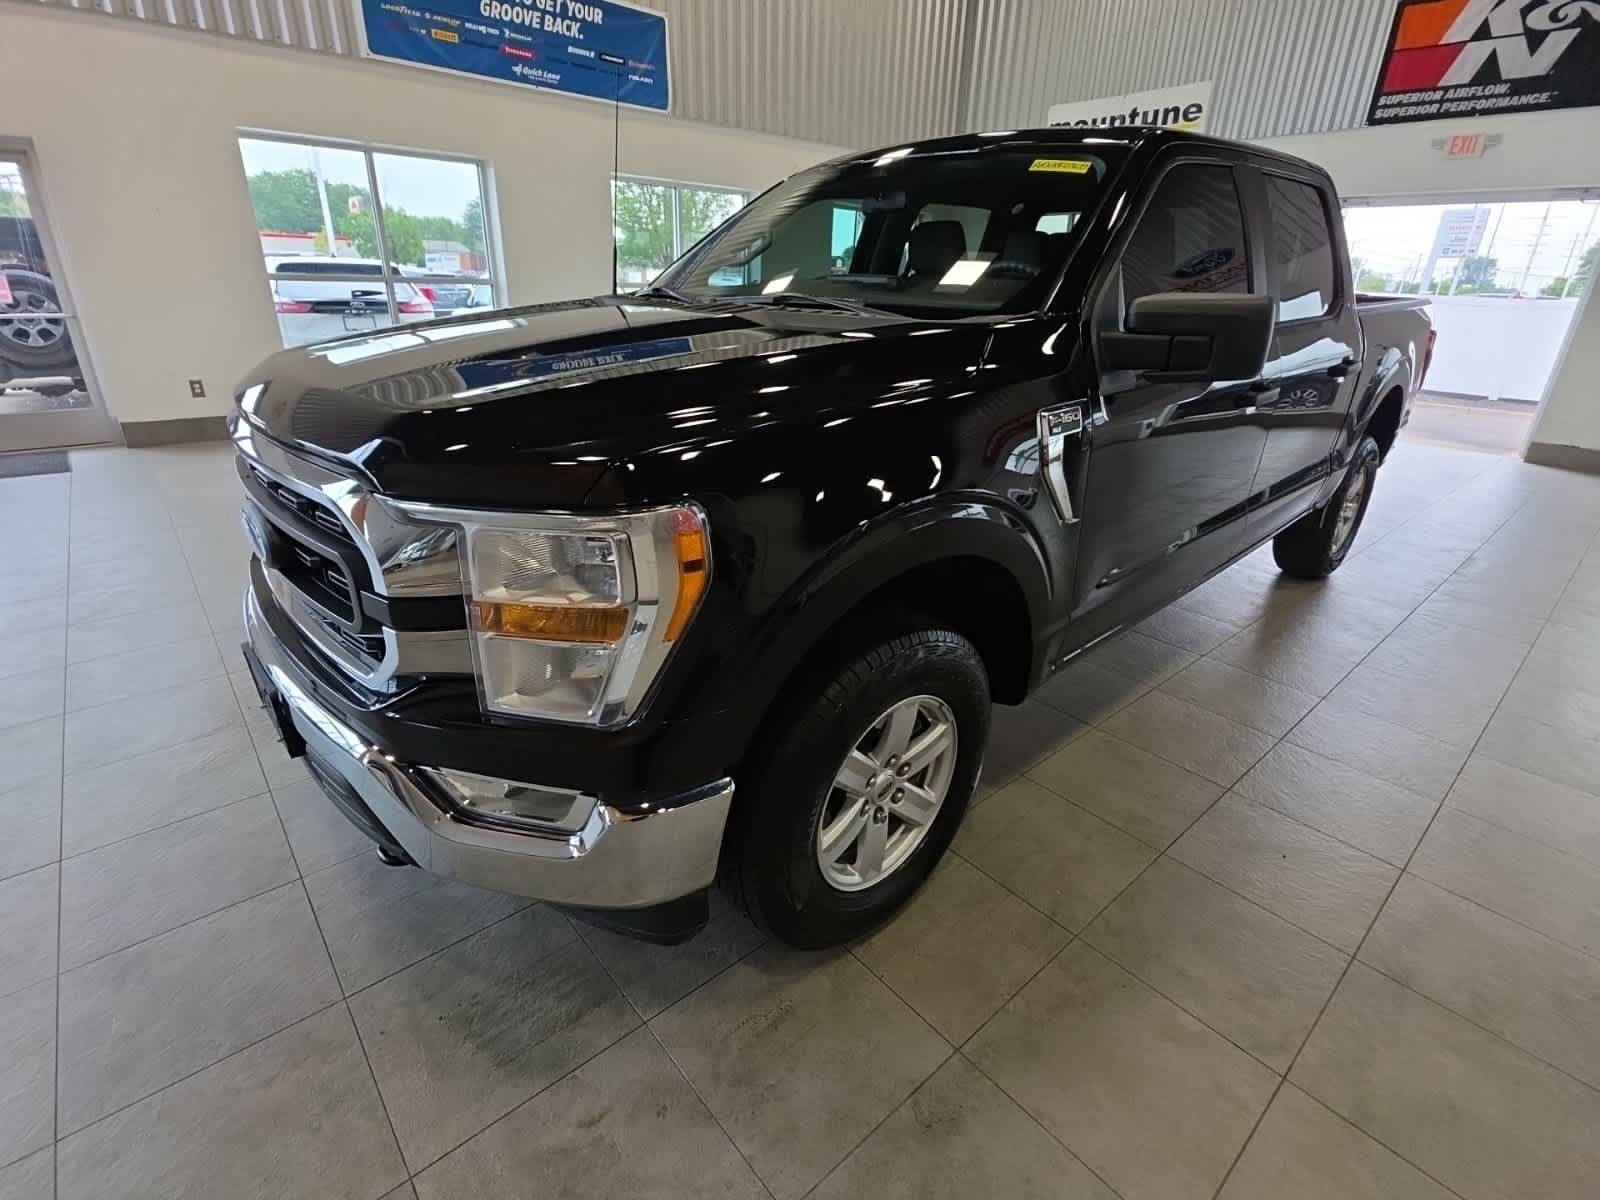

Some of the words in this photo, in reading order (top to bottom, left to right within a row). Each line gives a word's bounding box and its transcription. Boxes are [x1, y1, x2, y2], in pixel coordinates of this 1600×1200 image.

[480, 0, 542, 29] GROOVE
[544, 14, 584, 39] BACK.
[536, 0, 563, 13] GET
[566, 0, 603, 24] YOUR
[522, 66, 543, 77] Quick
[1374, 102, 1440, 119] SUPERIOR
[1440, 92, 1551, 113] PERFORMANCE.
[1378, 90, 1444, 106] SUPERIOR
[1444, 83, 1511, 99] AIRFLOW.
[1449, 134, 1481, 155] EXIT
